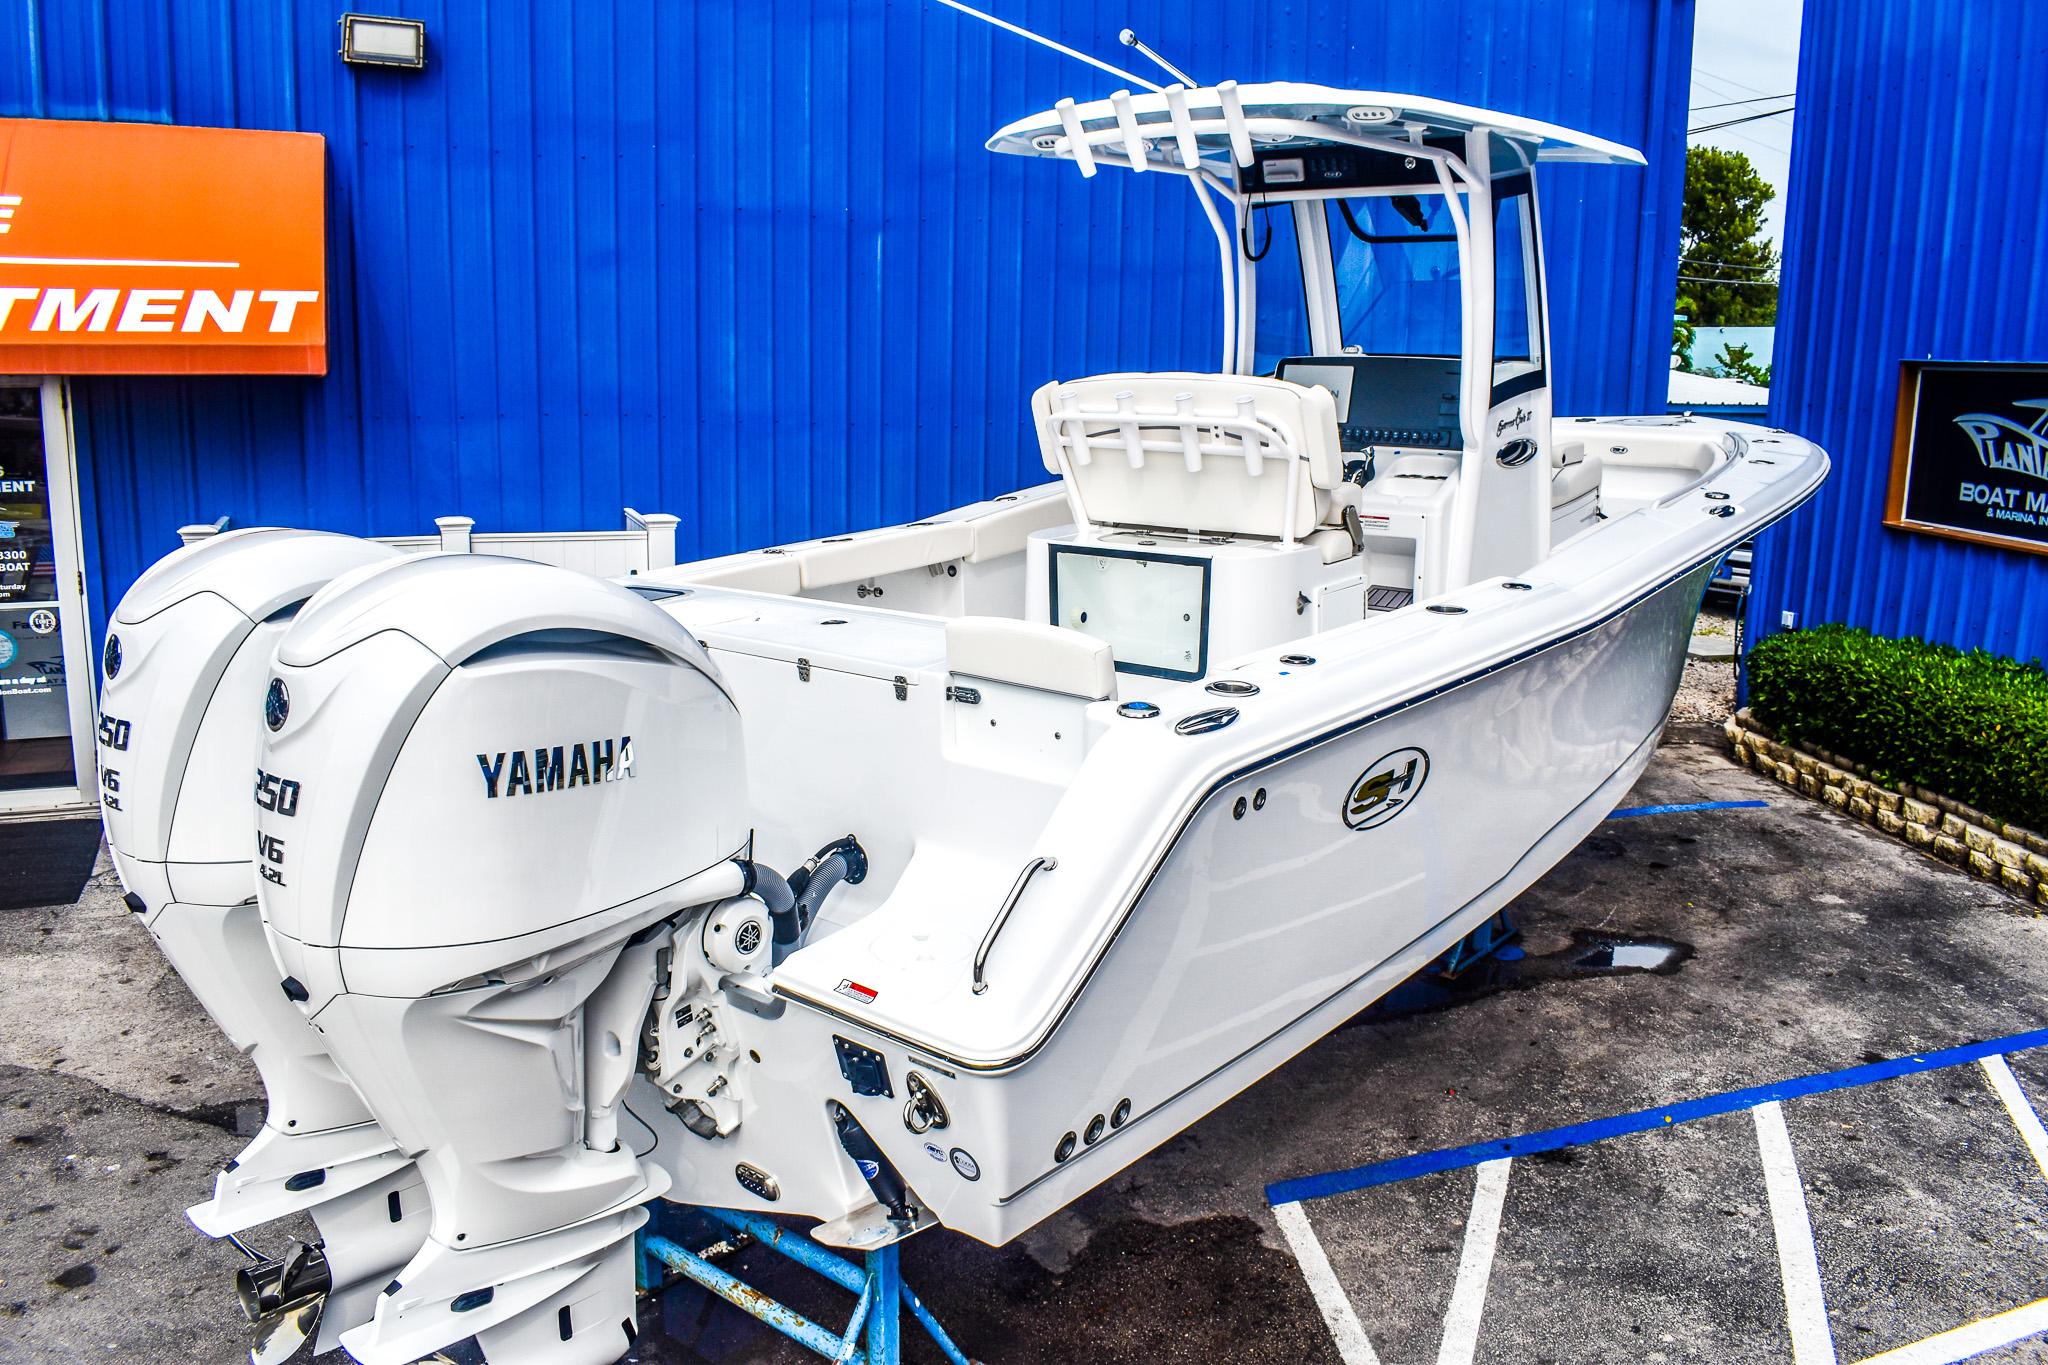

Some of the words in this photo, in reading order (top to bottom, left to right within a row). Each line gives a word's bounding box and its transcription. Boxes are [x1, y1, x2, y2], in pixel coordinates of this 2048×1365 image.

[0, 480, 35, 493] ENT
[1960, 482, 2020, 508] BOAT
[2025, 491, 2048, 513] M
[1986, 508, 1994, 517] &
[100, 764, 121, 792] V6
[476, 735, 636, 799] YAMAHA
[257, 829, 285, 864] V6
